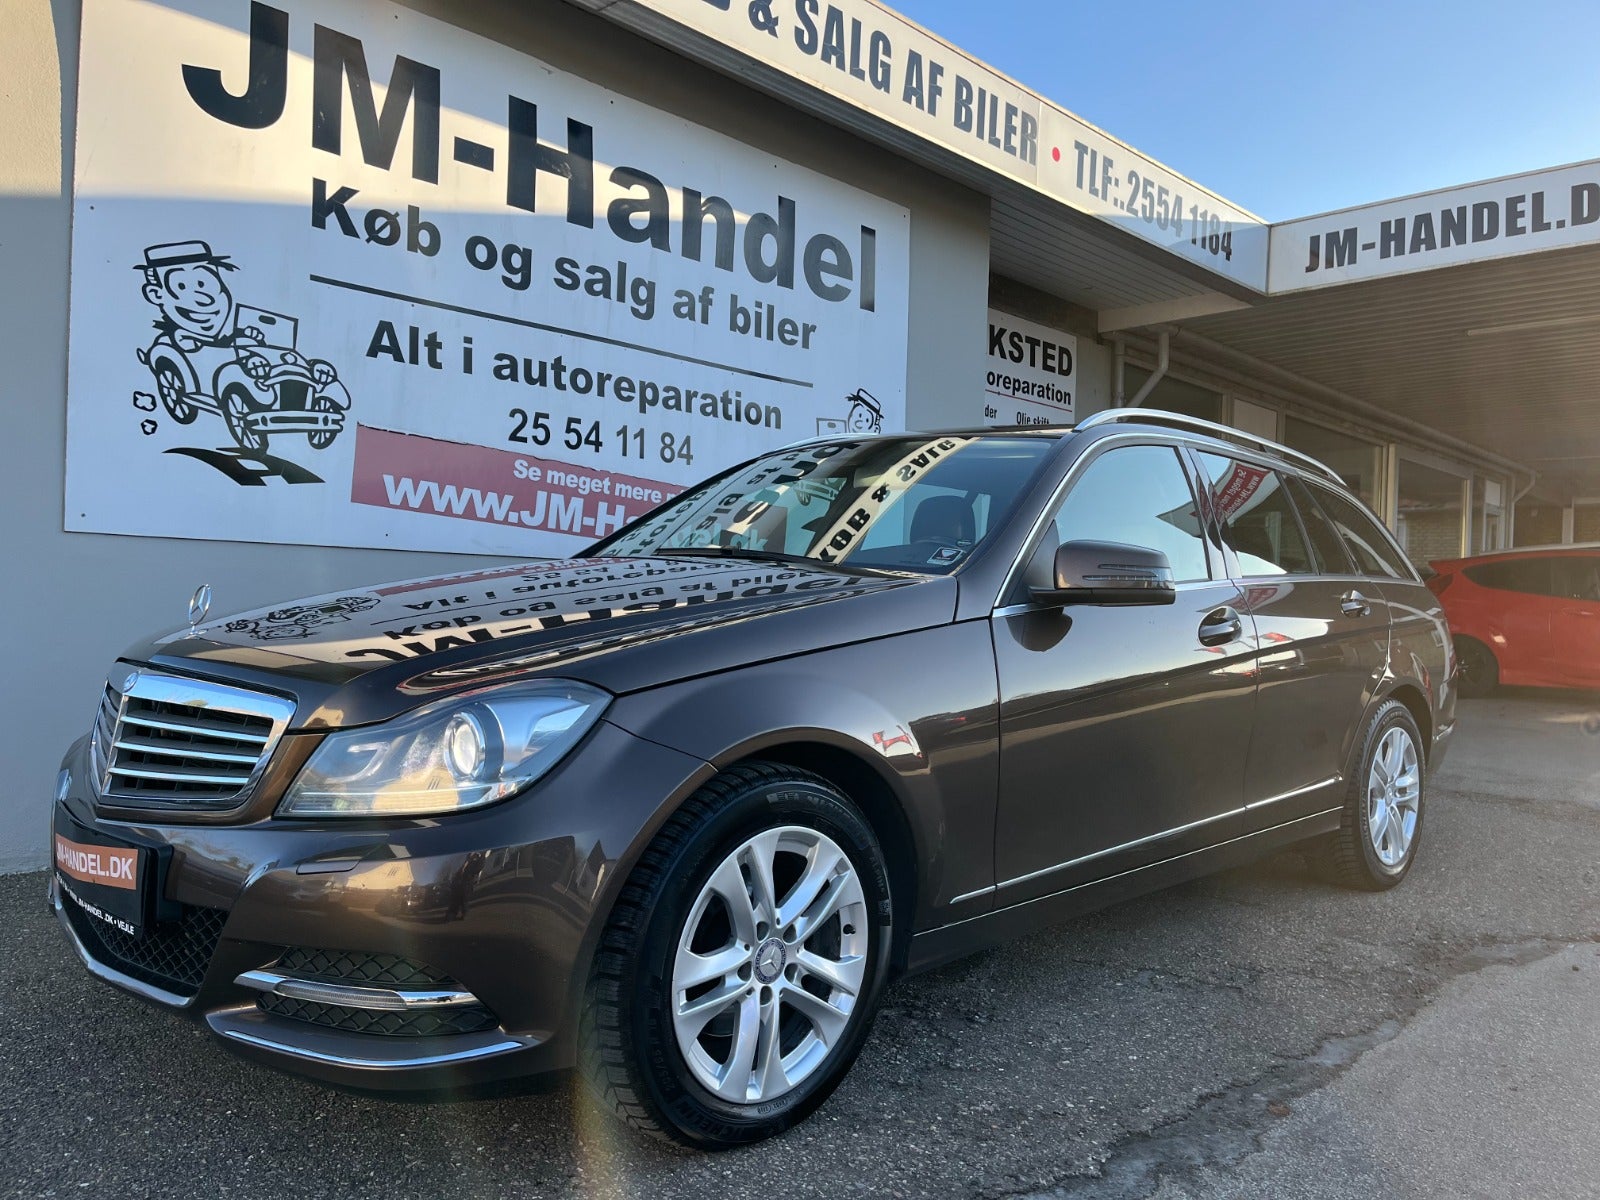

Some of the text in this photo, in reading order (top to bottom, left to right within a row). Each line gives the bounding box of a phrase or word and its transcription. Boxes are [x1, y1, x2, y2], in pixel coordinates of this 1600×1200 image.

[182, 0, 876, 312] JM-Handel
[748, 0, 779, 39] &
[794, 0, 891, 93] SALG
[902, 49, 944, 119] AF
[954, 75, 1039, 167] BILER
[1189, 204, 1233, 262] 1184
[311, 177, 817, 350] Køb og salg af biler
[366, 320, 782, 429] Alt i autoreparation
[988, 323, 1073, 377] KSTED
[986, 371, 1072, 406] oreparation
[508, 408, 694, 466] 25 54 11 84
[513, 459, 542, 482] Se
[547, 469, 611, 495] meget
[615, 482, 662, 504] mere
[56, 842, 134, 880] JM-HANDEL.DK
